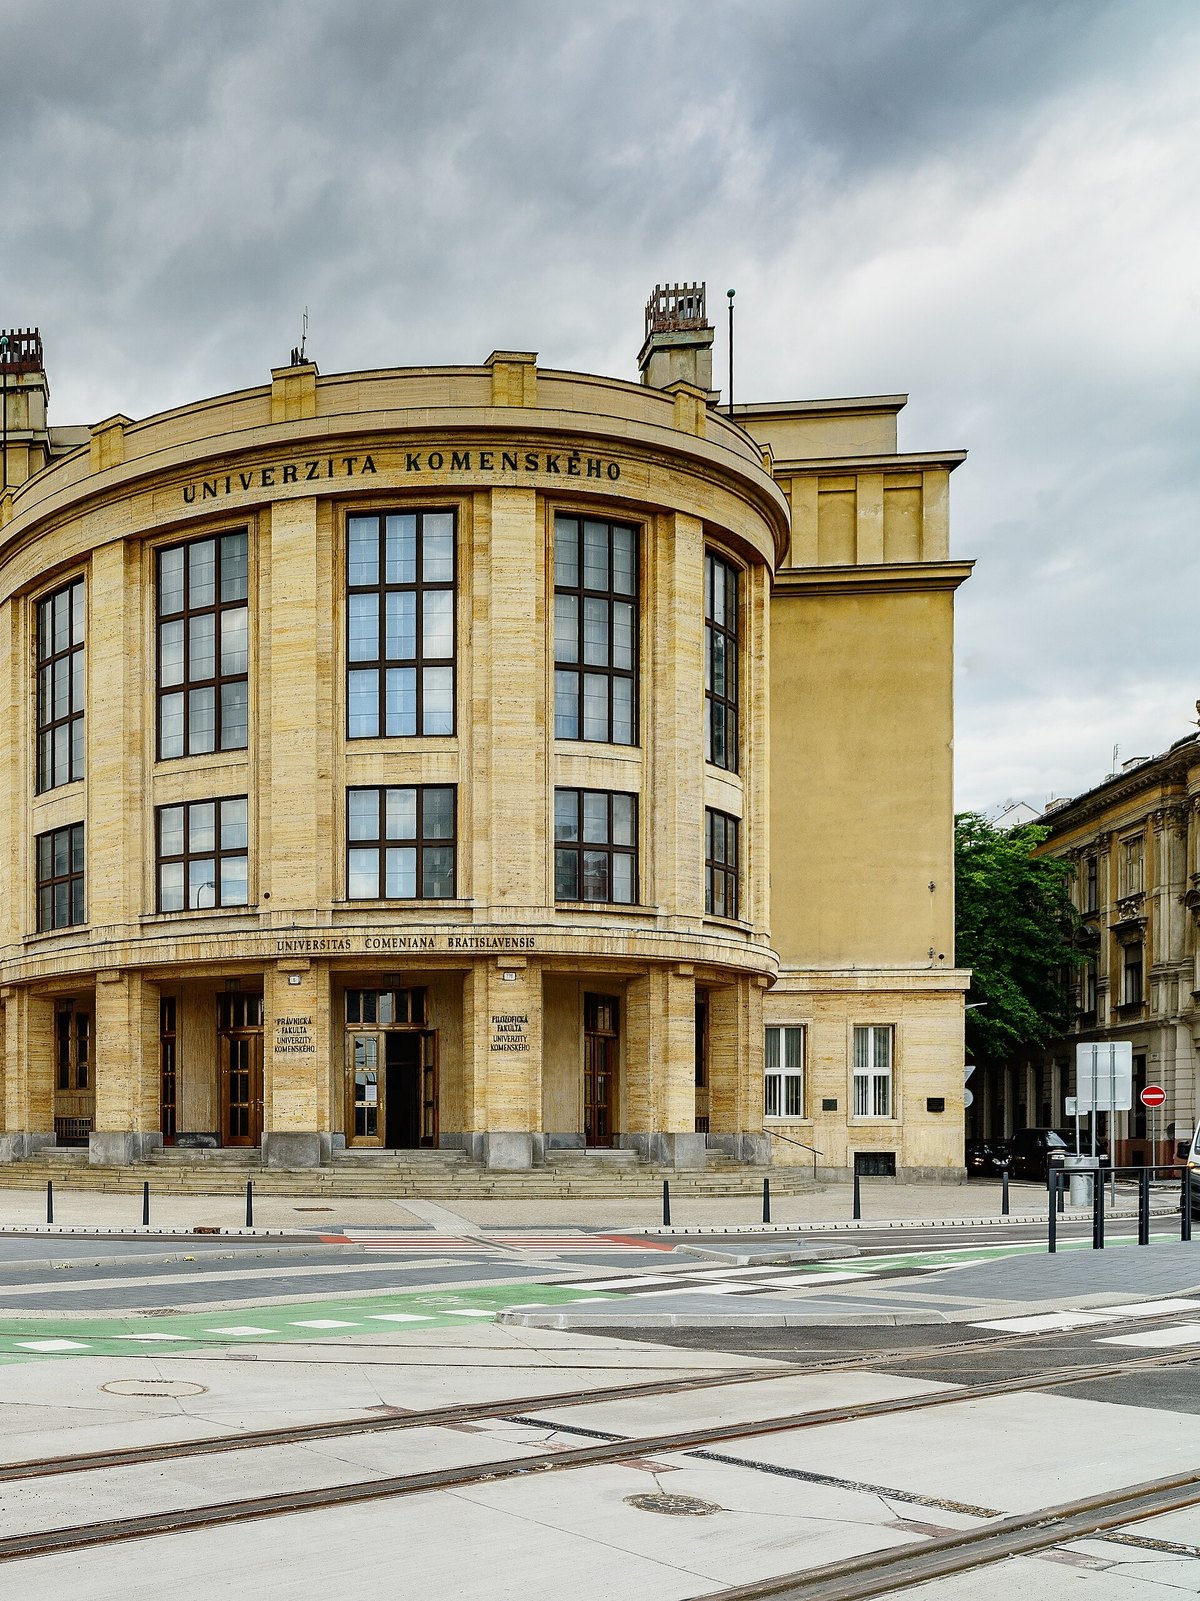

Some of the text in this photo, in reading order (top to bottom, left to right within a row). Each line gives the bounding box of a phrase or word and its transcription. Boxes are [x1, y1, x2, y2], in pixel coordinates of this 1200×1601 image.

[183, 451, 621, 503] UNIVERZITA KOMENSKÉHO
[277, 935, 535, 951] UNIVERSITAS COMENIANA BRATISLAVENSIS
[275, 1016, 313, 1026] PRÁVNICKÁ
[491, 1014, 529, 1024] FILOZOFICKÁ
[281, 1026, 308, 1035] FAKULTA
[497, 1024, 522, 1032] FAKULTA
[276, 1036, 313, 1045] UNIVERZITY
[492, 1034, 528, 1043] UNIVERZITY
[274, 1045, 316, 1053] KOMENSKÉHO
[490, 1043, 531, 1052] KOMENSKÉHO
